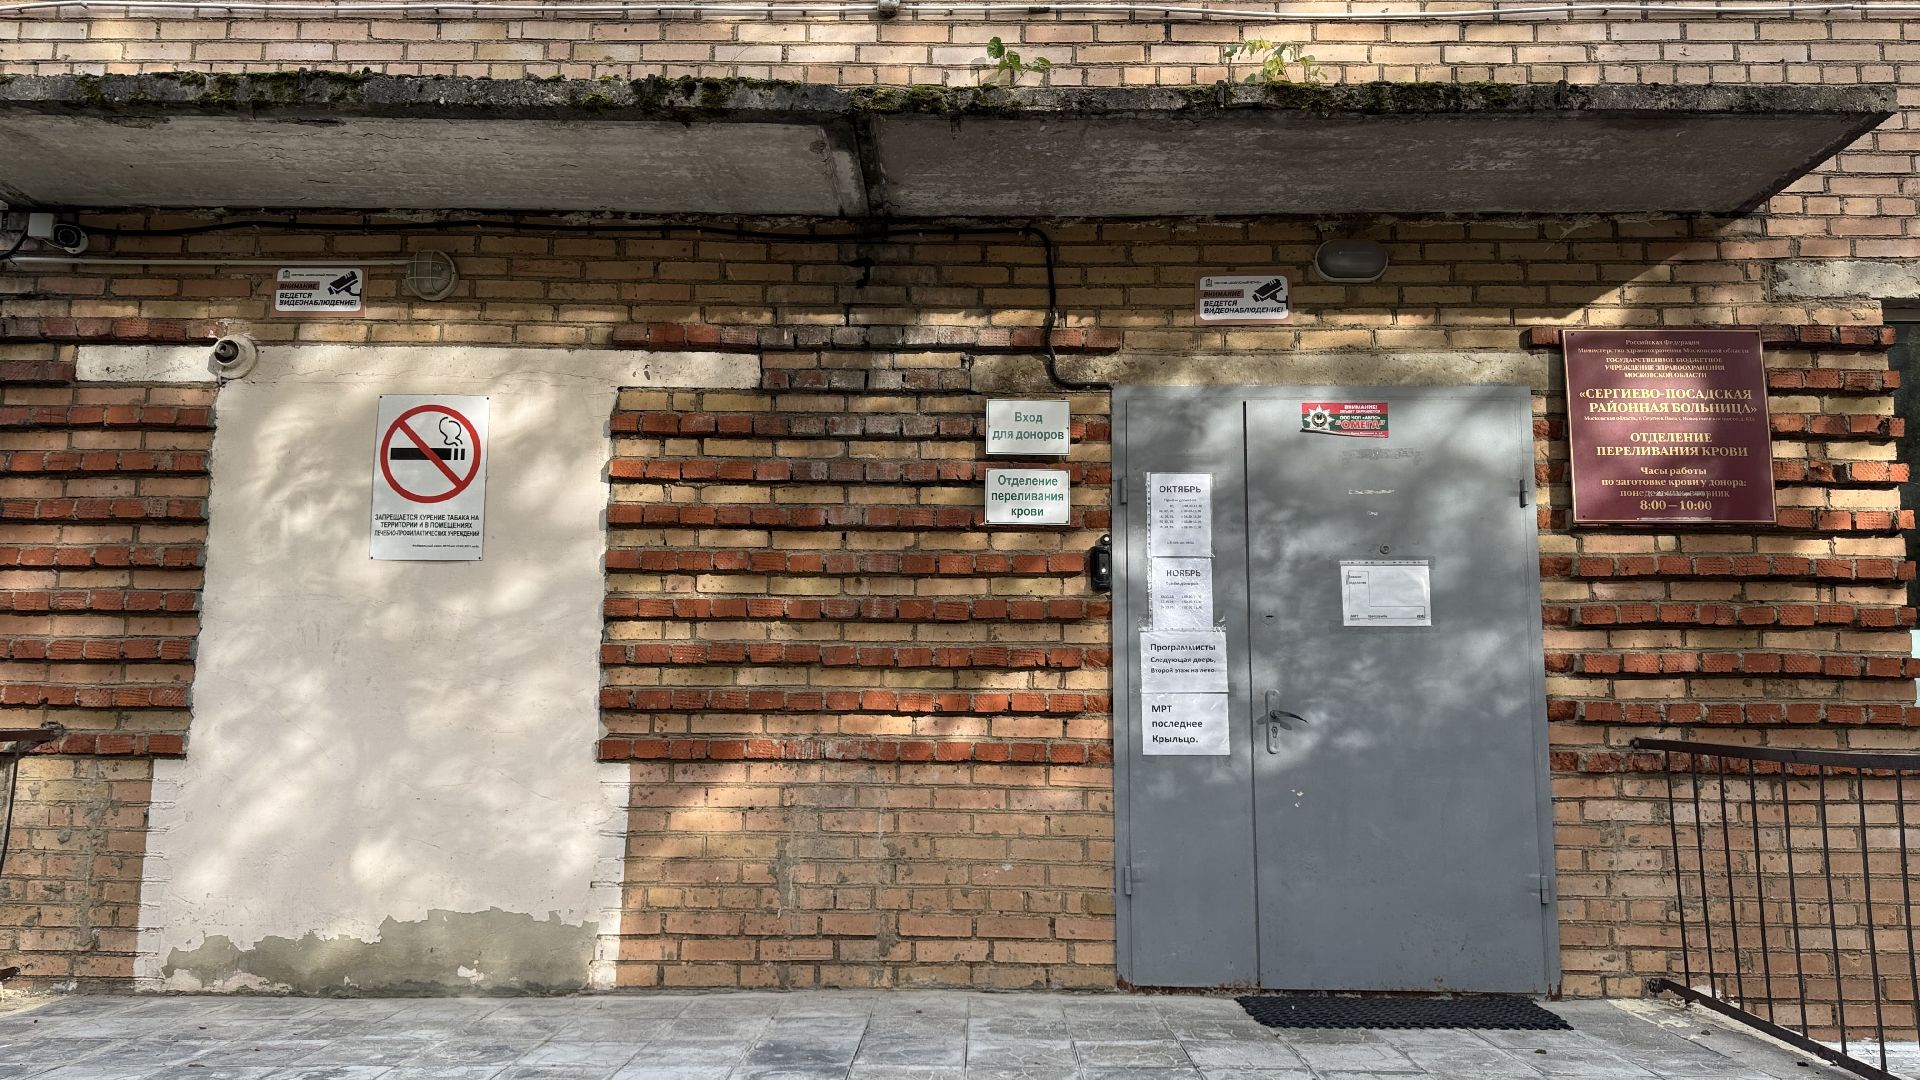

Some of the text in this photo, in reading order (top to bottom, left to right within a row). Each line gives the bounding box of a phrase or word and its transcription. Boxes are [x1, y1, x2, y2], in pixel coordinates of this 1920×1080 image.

[1579, 388, 1752, 400] «СЕРГИЕВО-ПОСАДСКАЯ
[1589, 400, 1757, 415] РАЙОННАЯ БОЛЬНИЦА»
[1014, 412, 1042, 424] Вход
[992, 431, 1064, 441] для доноров
[1630, 433, 1712, 444] ОТДЕЛЕНИЕ
[1596, 447, 1748, 457] ПЕРЕЛИВАНИЯ КРОВИ
[1640, 467, 1707, 476] Часы работы
[998, 475, 1058, 487] Отделение
[1700, 480, 1706, 488] у
[1709, 480, 1747, 488] донора:
[992, 492, 1064, 503] переливания
[1640, 500, 1666, 510] 8:00
[1680, 500, 1712, 510] 10:00
[1011, 508, 1044, 518] крови
[1150, 644, 1216, 652] Программисты
[1152, 720, 1203, 729] последнее
[1152, 735, 1198, 744] Крыльцо.
